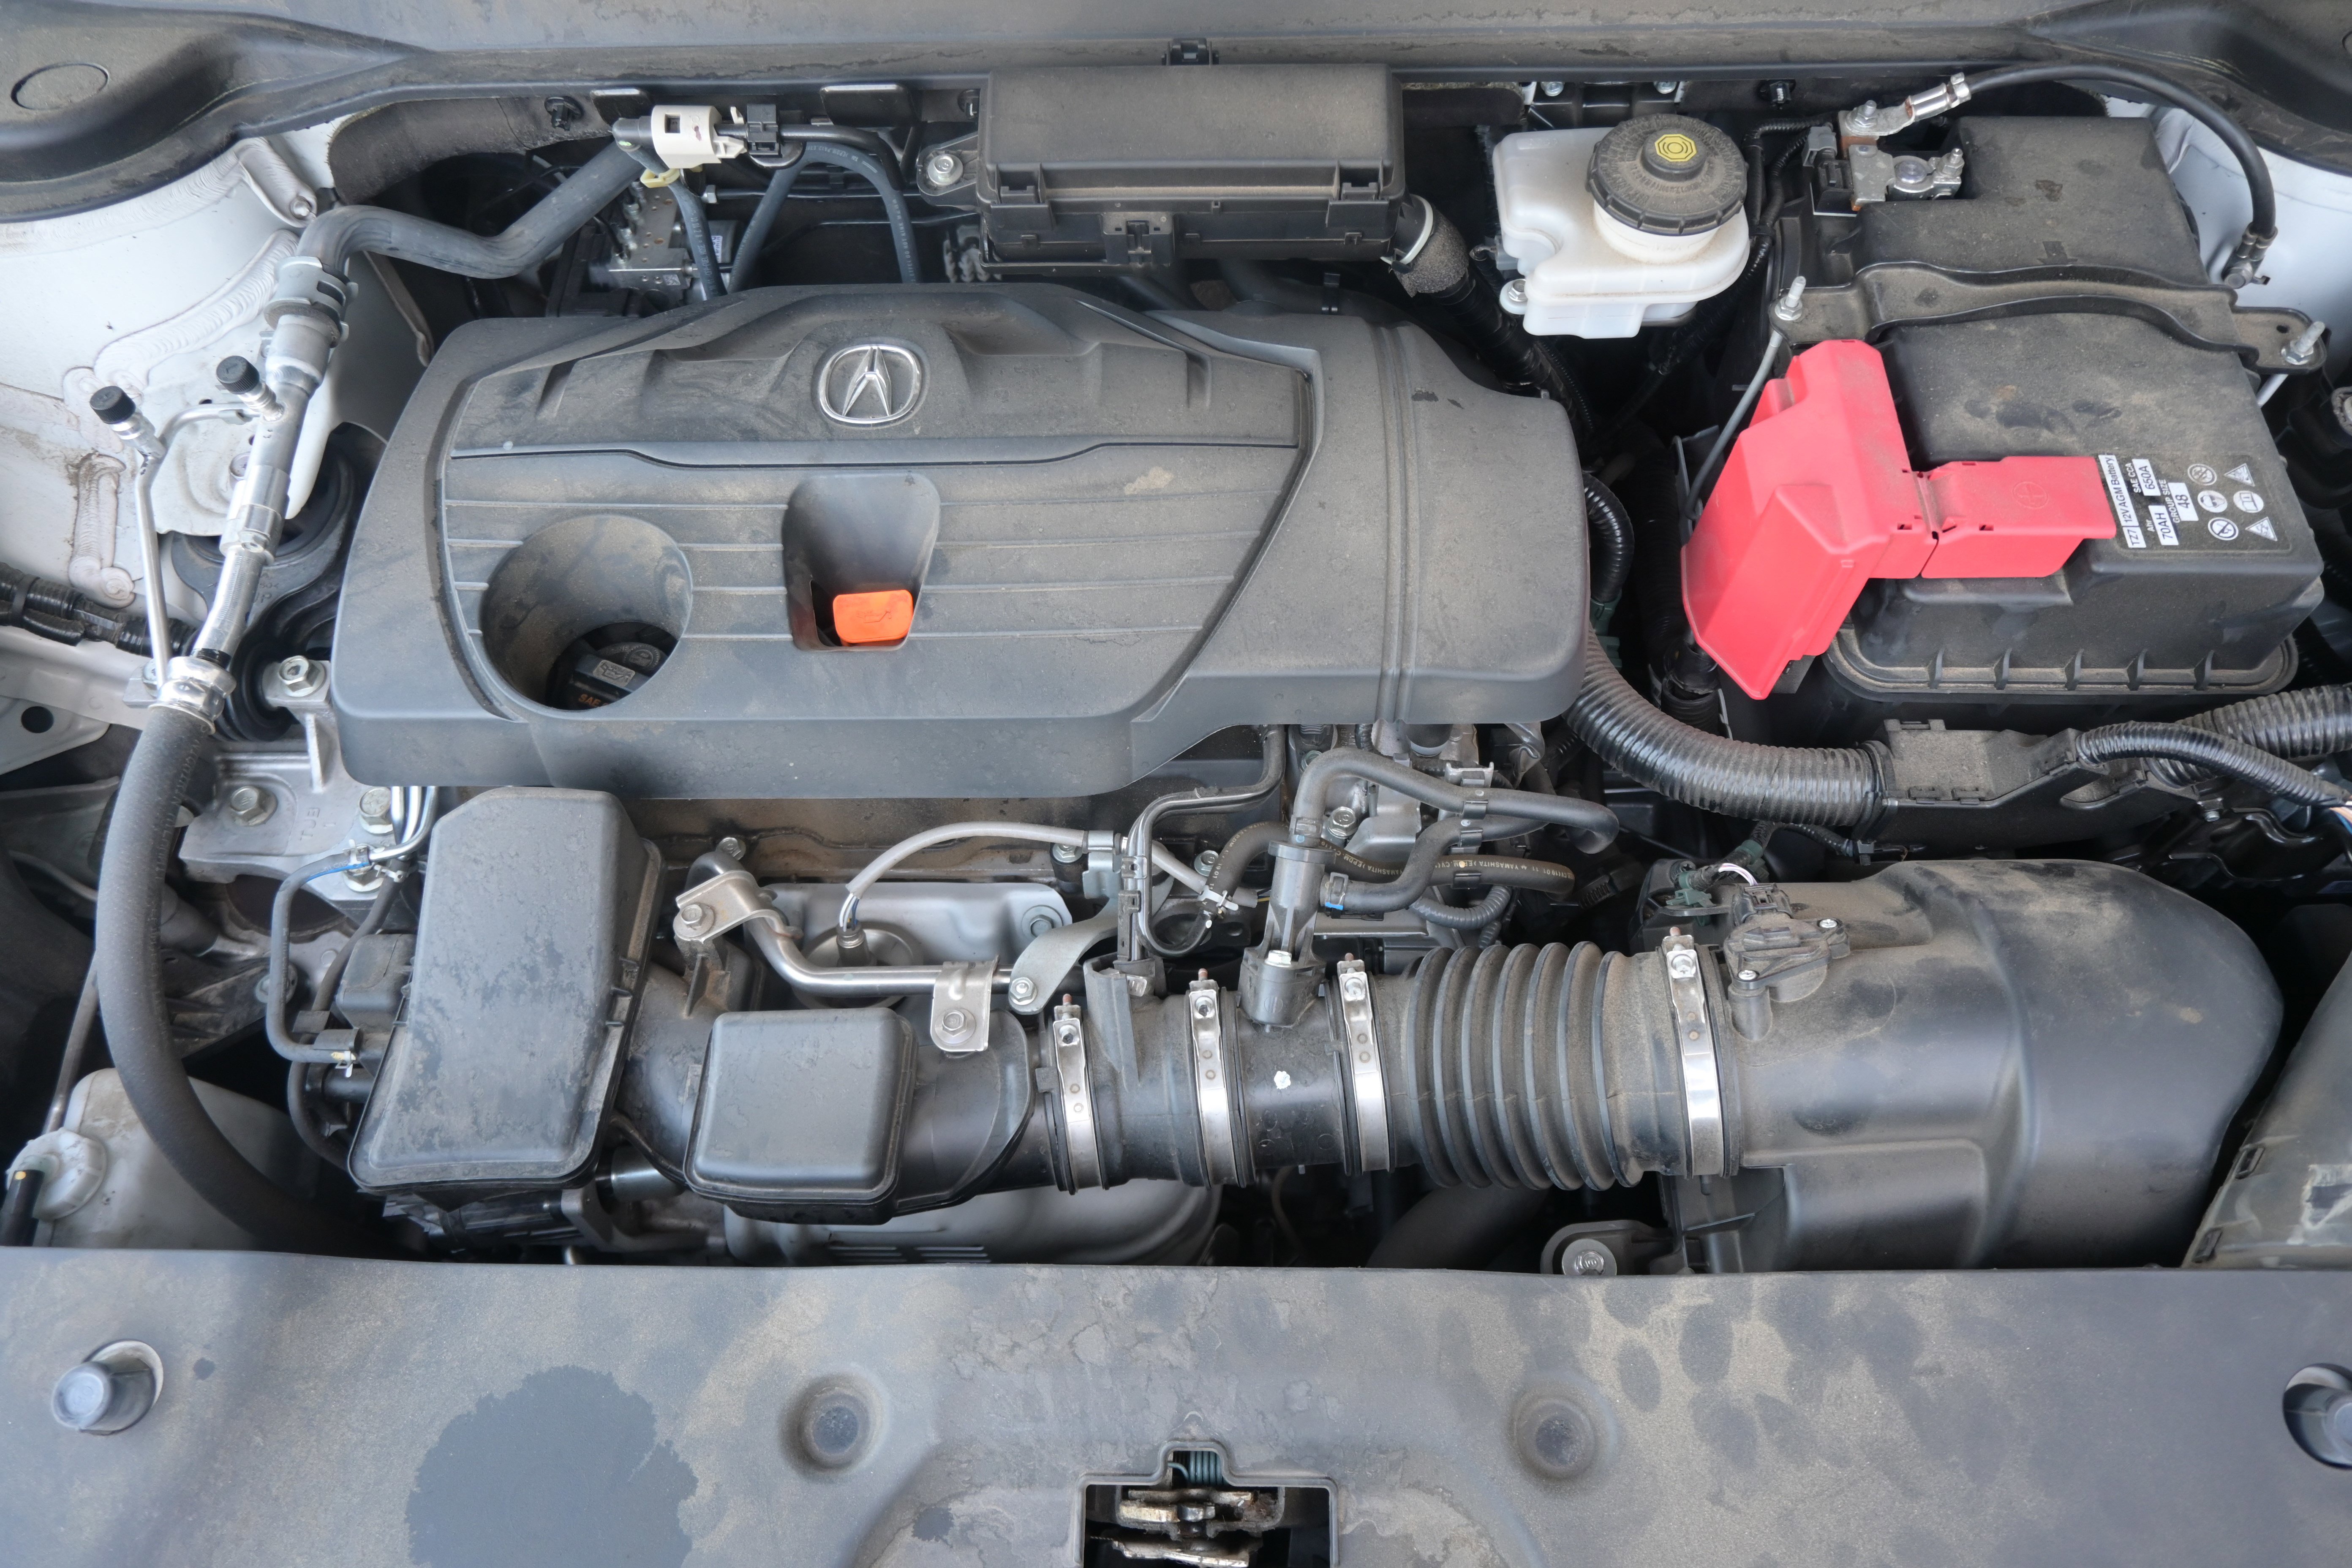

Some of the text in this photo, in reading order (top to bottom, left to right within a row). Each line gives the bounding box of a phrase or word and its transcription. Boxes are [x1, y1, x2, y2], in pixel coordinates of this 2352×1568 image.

[2125, 462, 2142, 493] SAE CCA
[2139, 466, 2156, 490] 650A
[2105, 457, 2133, 523] 12V AGM Battery
[2159, 479, 2180, 523] GROUP SIZE
[2175, 494, 2190, 509] 48
[2146, 519, 2155, 532] Ahr
[2155, 512, 2173, 539] 70AH
[2127, 529, 2140, 546] TZ7
[578, 694, 602, 707] SAE
[1479, 861, 1519, 870] YAMASHITA
